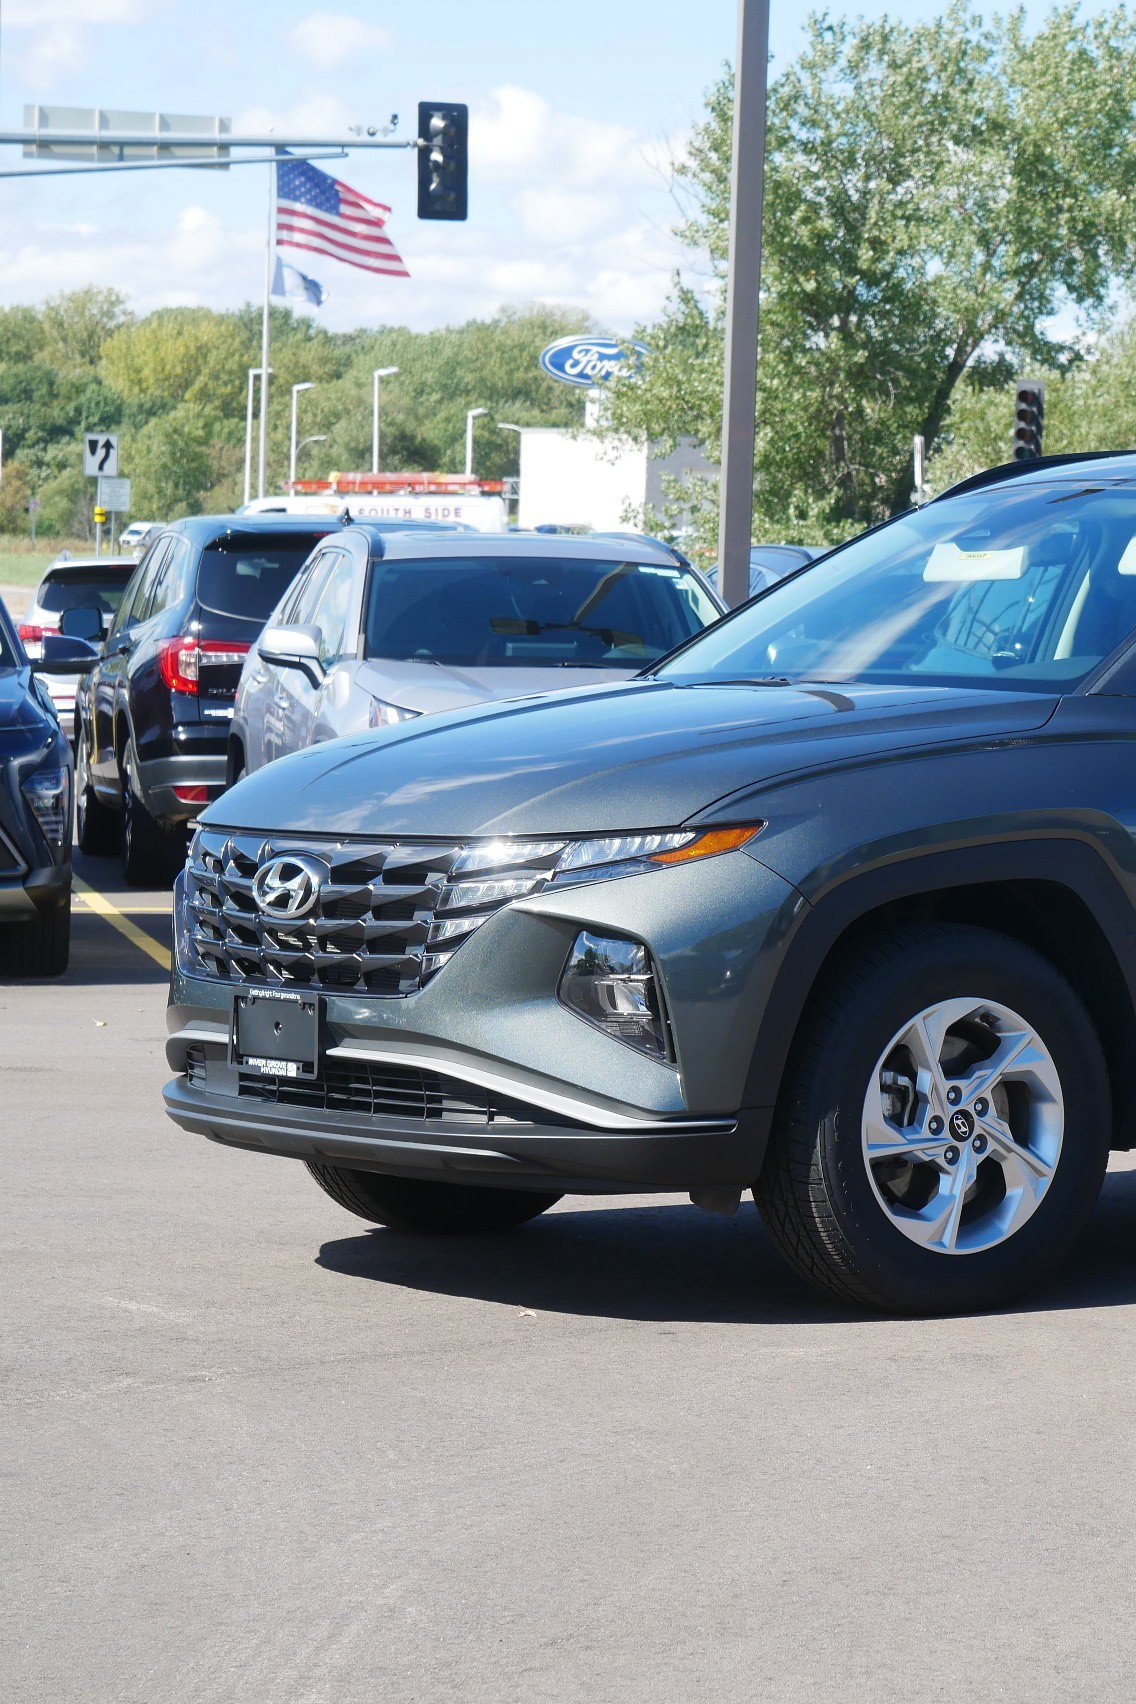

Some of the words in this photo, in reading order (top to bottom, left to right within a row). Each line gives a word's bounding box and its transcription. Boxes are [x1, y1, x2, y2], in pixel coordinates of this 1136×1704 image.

[424, 507, 462, 519] SIDE
[248, 1057, 267, 1067] INVER
[267, 1060, 287, 1069] GROVE
[260, 1066, 287, 1076] HYUNDAI
